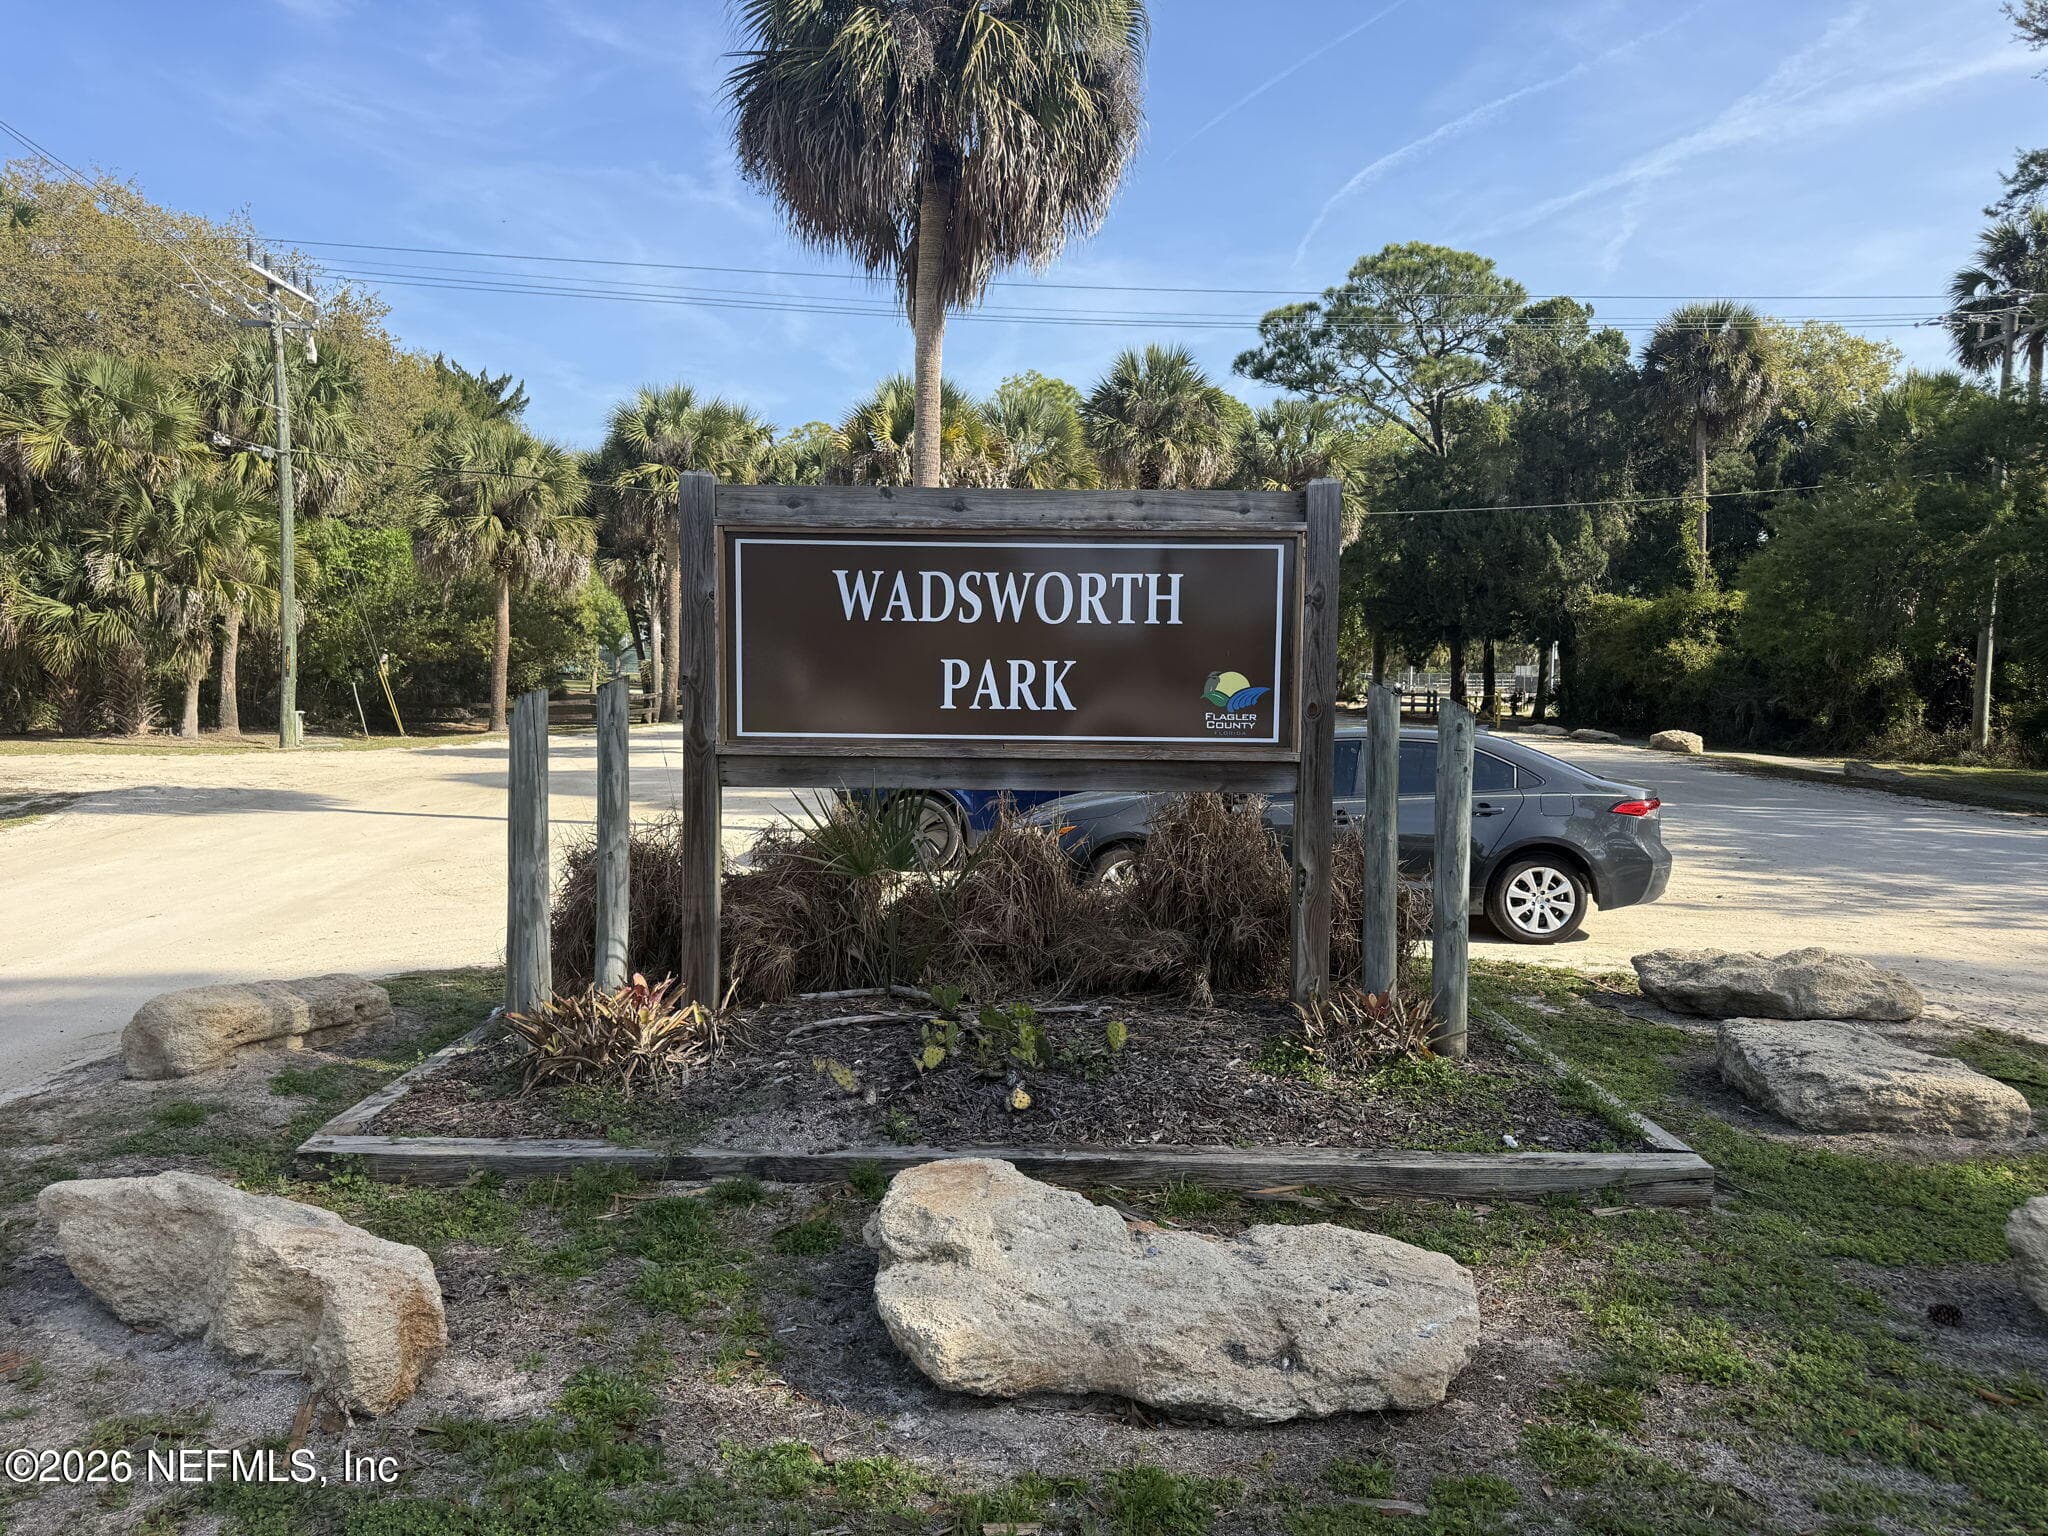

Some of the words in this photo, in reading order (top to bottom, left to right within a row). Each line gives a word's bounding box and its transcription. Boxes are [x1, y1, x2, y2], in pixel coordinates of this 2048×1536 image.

[832, 569, 1184, 625] WADSWORTH
[939, 658, 1077, 711] PARK
[1205, 712, 1257, 721] FLAGLER
[1206, 721, 1256, 729] COUNTY
